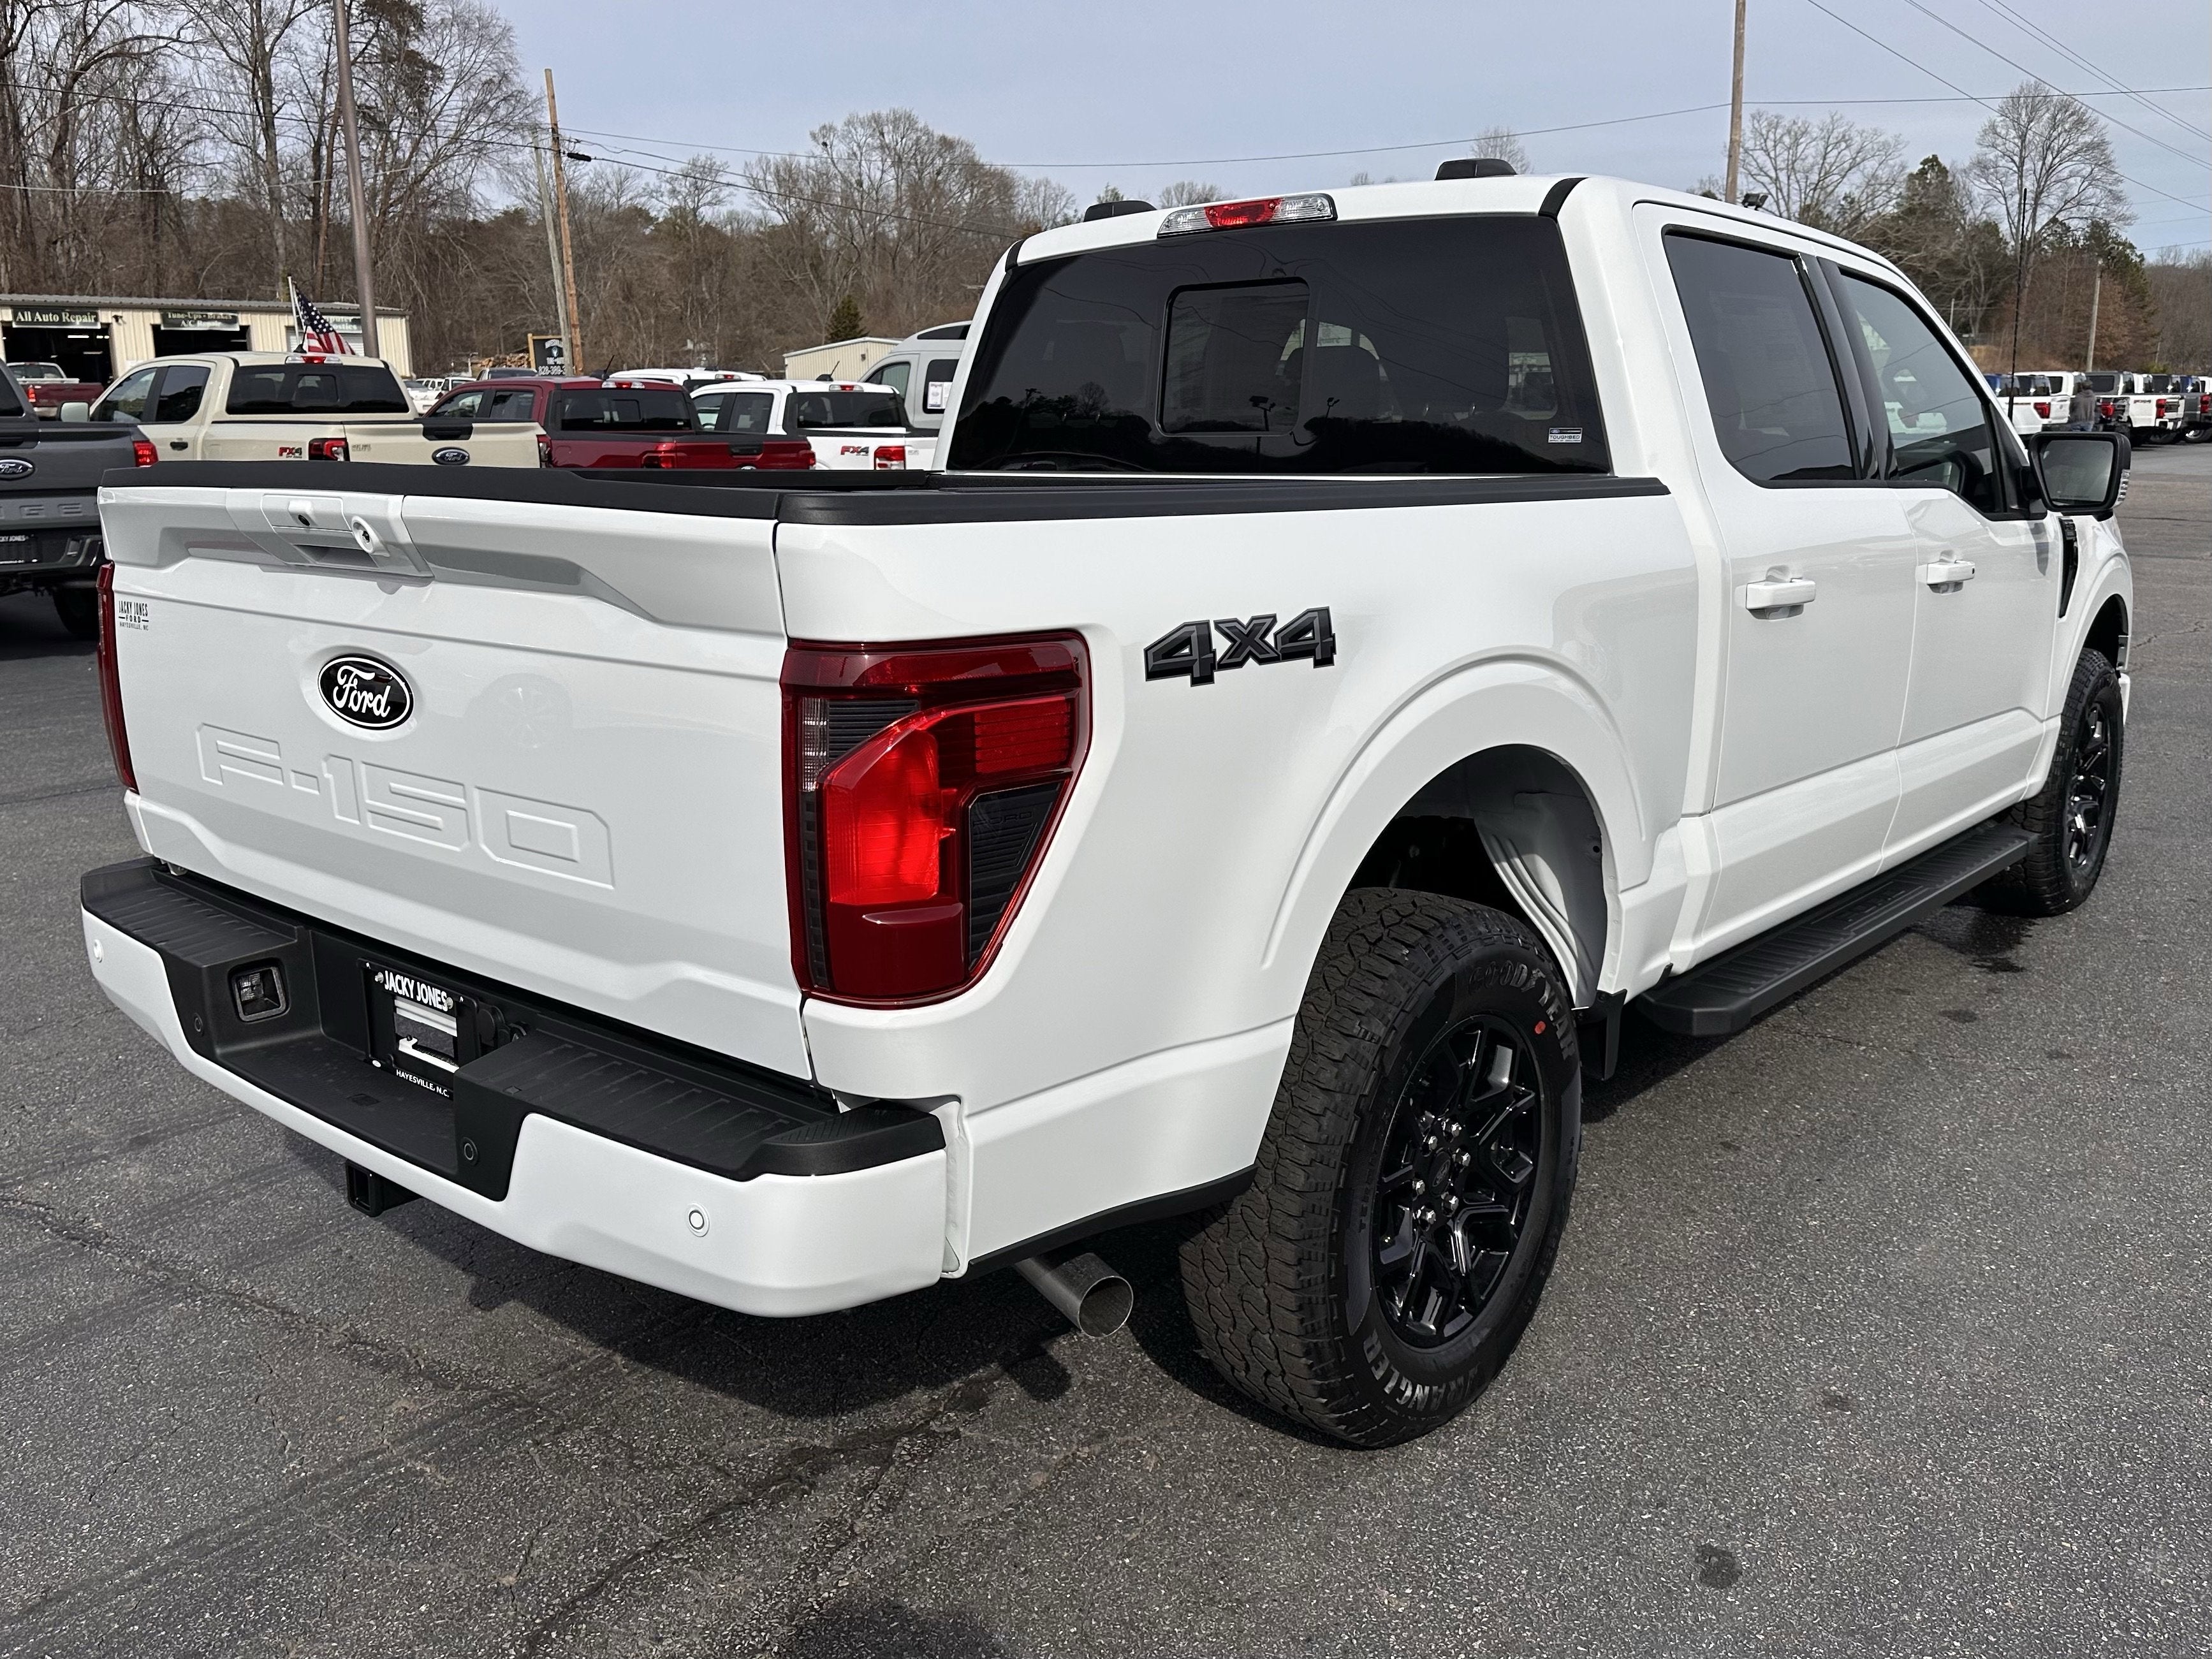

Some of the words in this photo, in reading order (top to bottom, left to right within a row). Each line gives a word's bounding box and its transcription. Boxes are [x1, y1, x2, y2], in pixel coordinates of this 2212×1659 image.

[16, 311, 31, 322] All
[33, 311, 59, 323] Auto
[62, 312, 96, 325] Repair
[278, 446, 302, 457] FX4
[840, 446, 870, 455] FX4
[119, 601, 132, 614] JACKY
[134, 602, 148, 617] JONES
[126, 615, 141, 624] FORD
[333, 665, 390, 719] Ford
[196, 722, 615, 889] F-150
[385, 970, 414, 998] JACKY
[416, 982, 449, 1012] JONES
[396, 1069, 436, 1091] HAYESVILLE,
